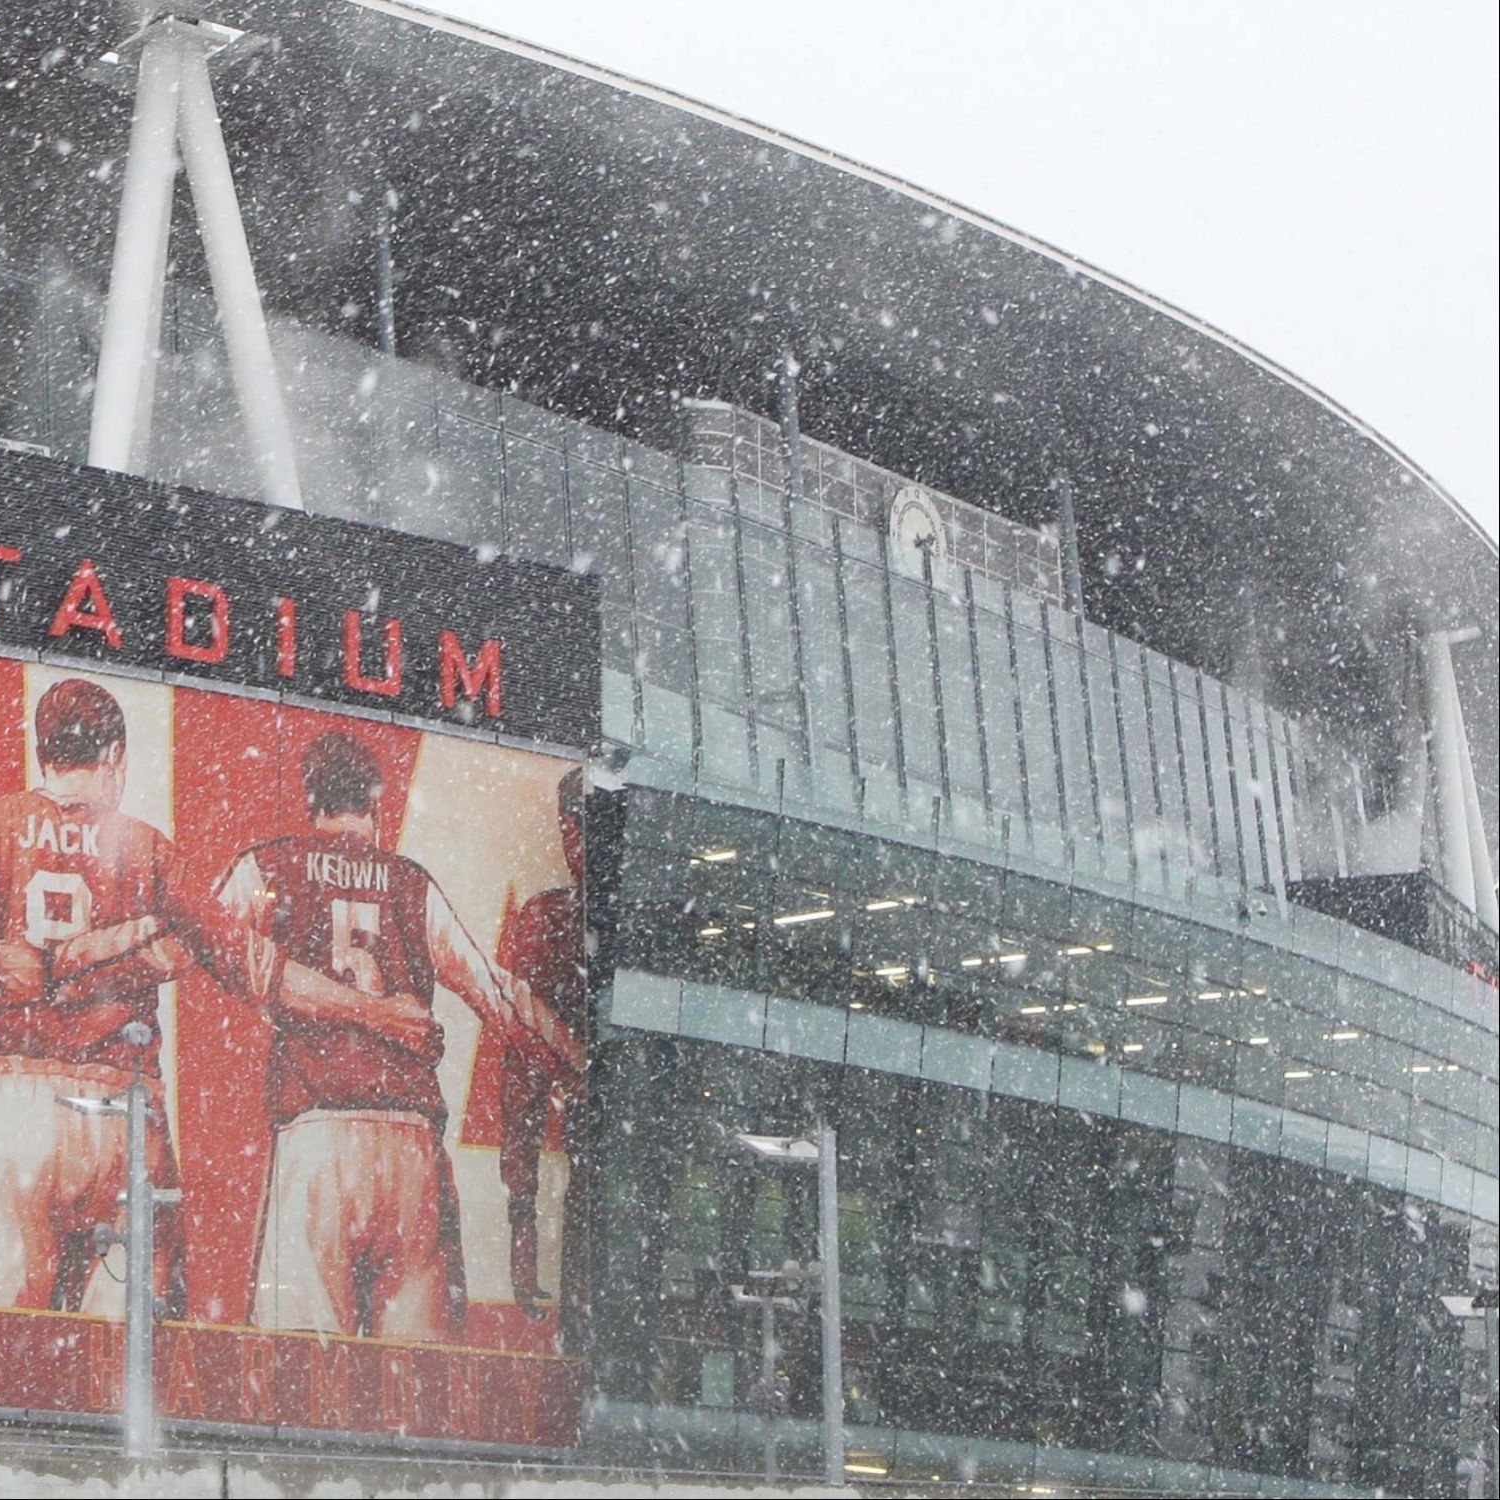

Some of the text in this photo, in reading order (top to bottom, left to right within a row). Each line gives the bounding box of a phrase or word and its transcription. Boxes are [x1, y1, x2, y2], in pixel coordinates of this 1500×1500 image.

[18, 813, 100, 857] JACK
[305, 852, 389, 893] KEOWN
[331, 898, 385, 997] 5
